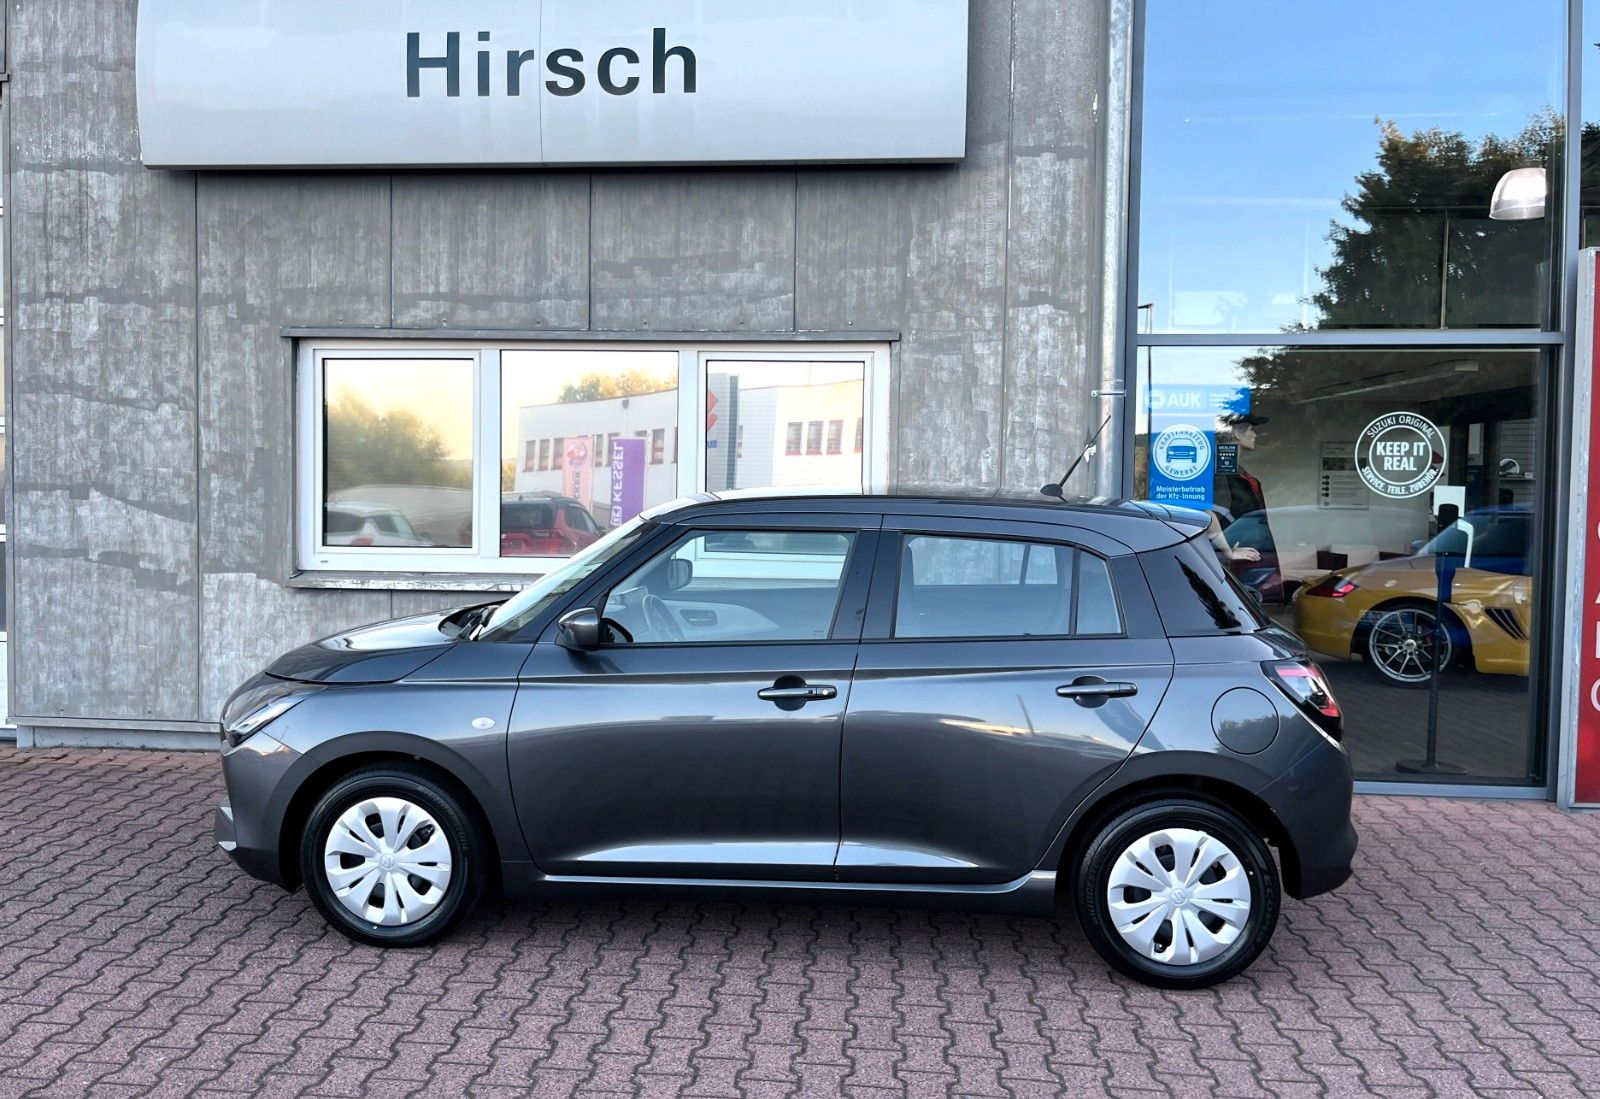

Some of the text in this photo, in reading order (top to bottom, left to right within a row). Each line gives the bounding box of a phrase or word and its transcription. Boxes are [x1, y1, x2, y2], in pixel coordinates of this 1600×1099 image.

[406, 27, 697, 97] Hirsch
[1367, 415, 1436, 439] SUZUKI ORIGINAL
[1376, 441, 1426, 456] KEEP IT
[1383, 457, 1418, 471] REAL
[1361, 465, 1386, 491] SERVICE.
[1156, 485, 1206, 493] Meisterbetrieb
[1168, 493, 1205, 501] Kfz-Innung
